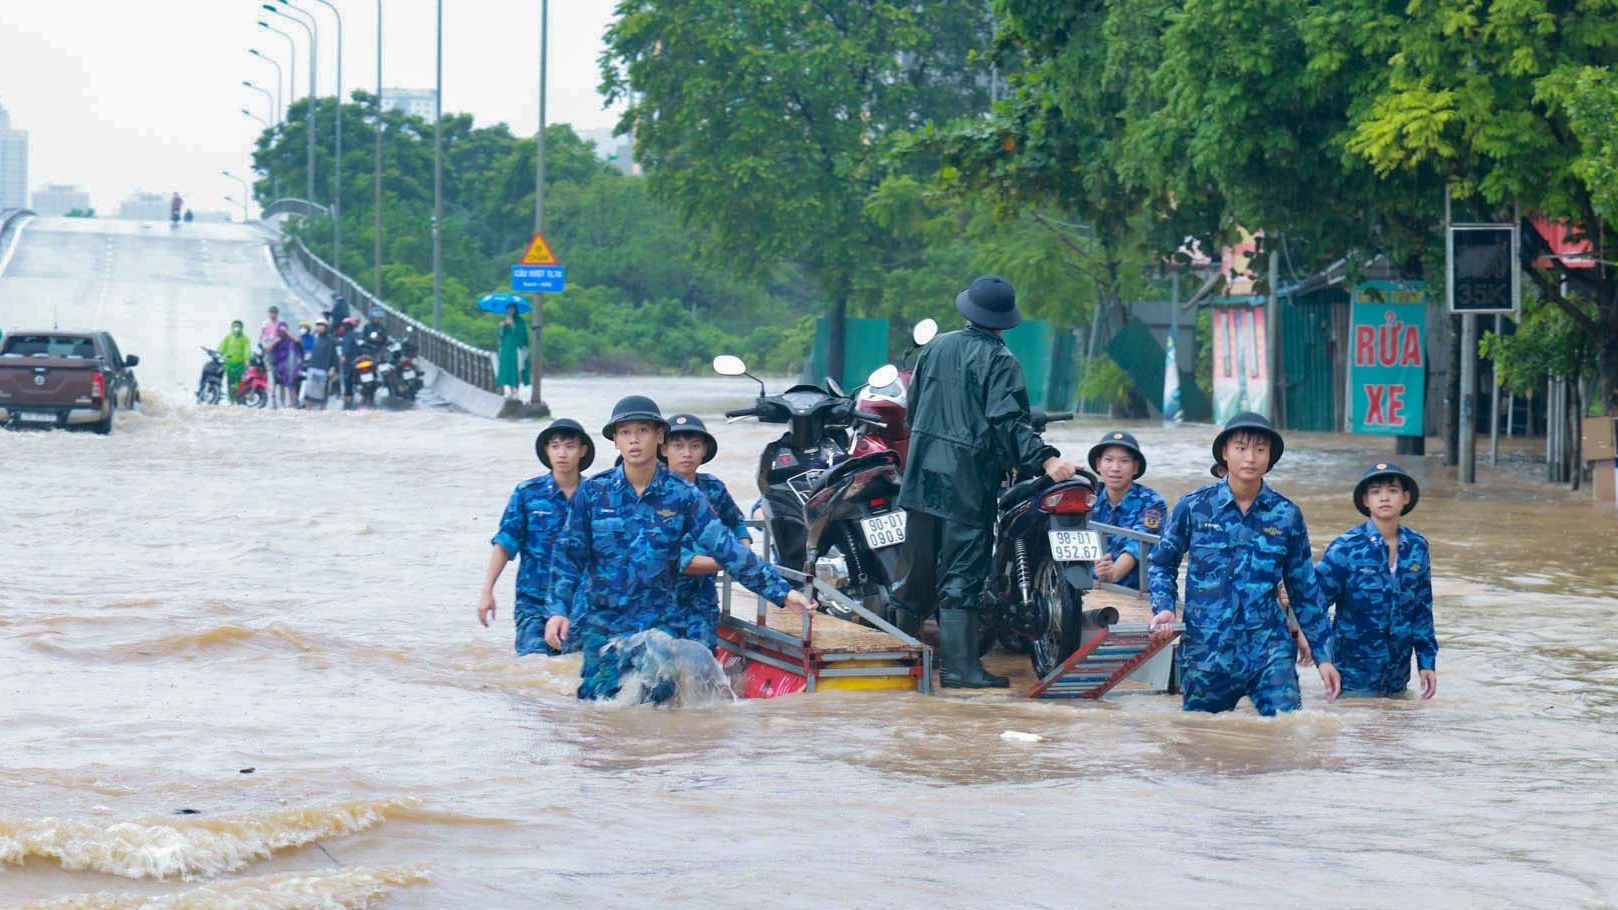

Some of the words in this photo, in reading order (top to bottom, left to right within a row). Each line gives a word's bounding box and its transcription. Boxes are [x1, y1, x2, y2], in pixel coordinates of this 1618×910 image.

[1457, 284, 1507, 304] 35K
[1355, 310, 1422, 367] RỬA
[1364, 384, 1406, 426] XE
[869, 513, 903, 531] 90-01
[870, 528, 905, 546] 090.9
[1057, 532, 1091, 544] 98-01
[1056, 545, 1098, 558] 952.67
